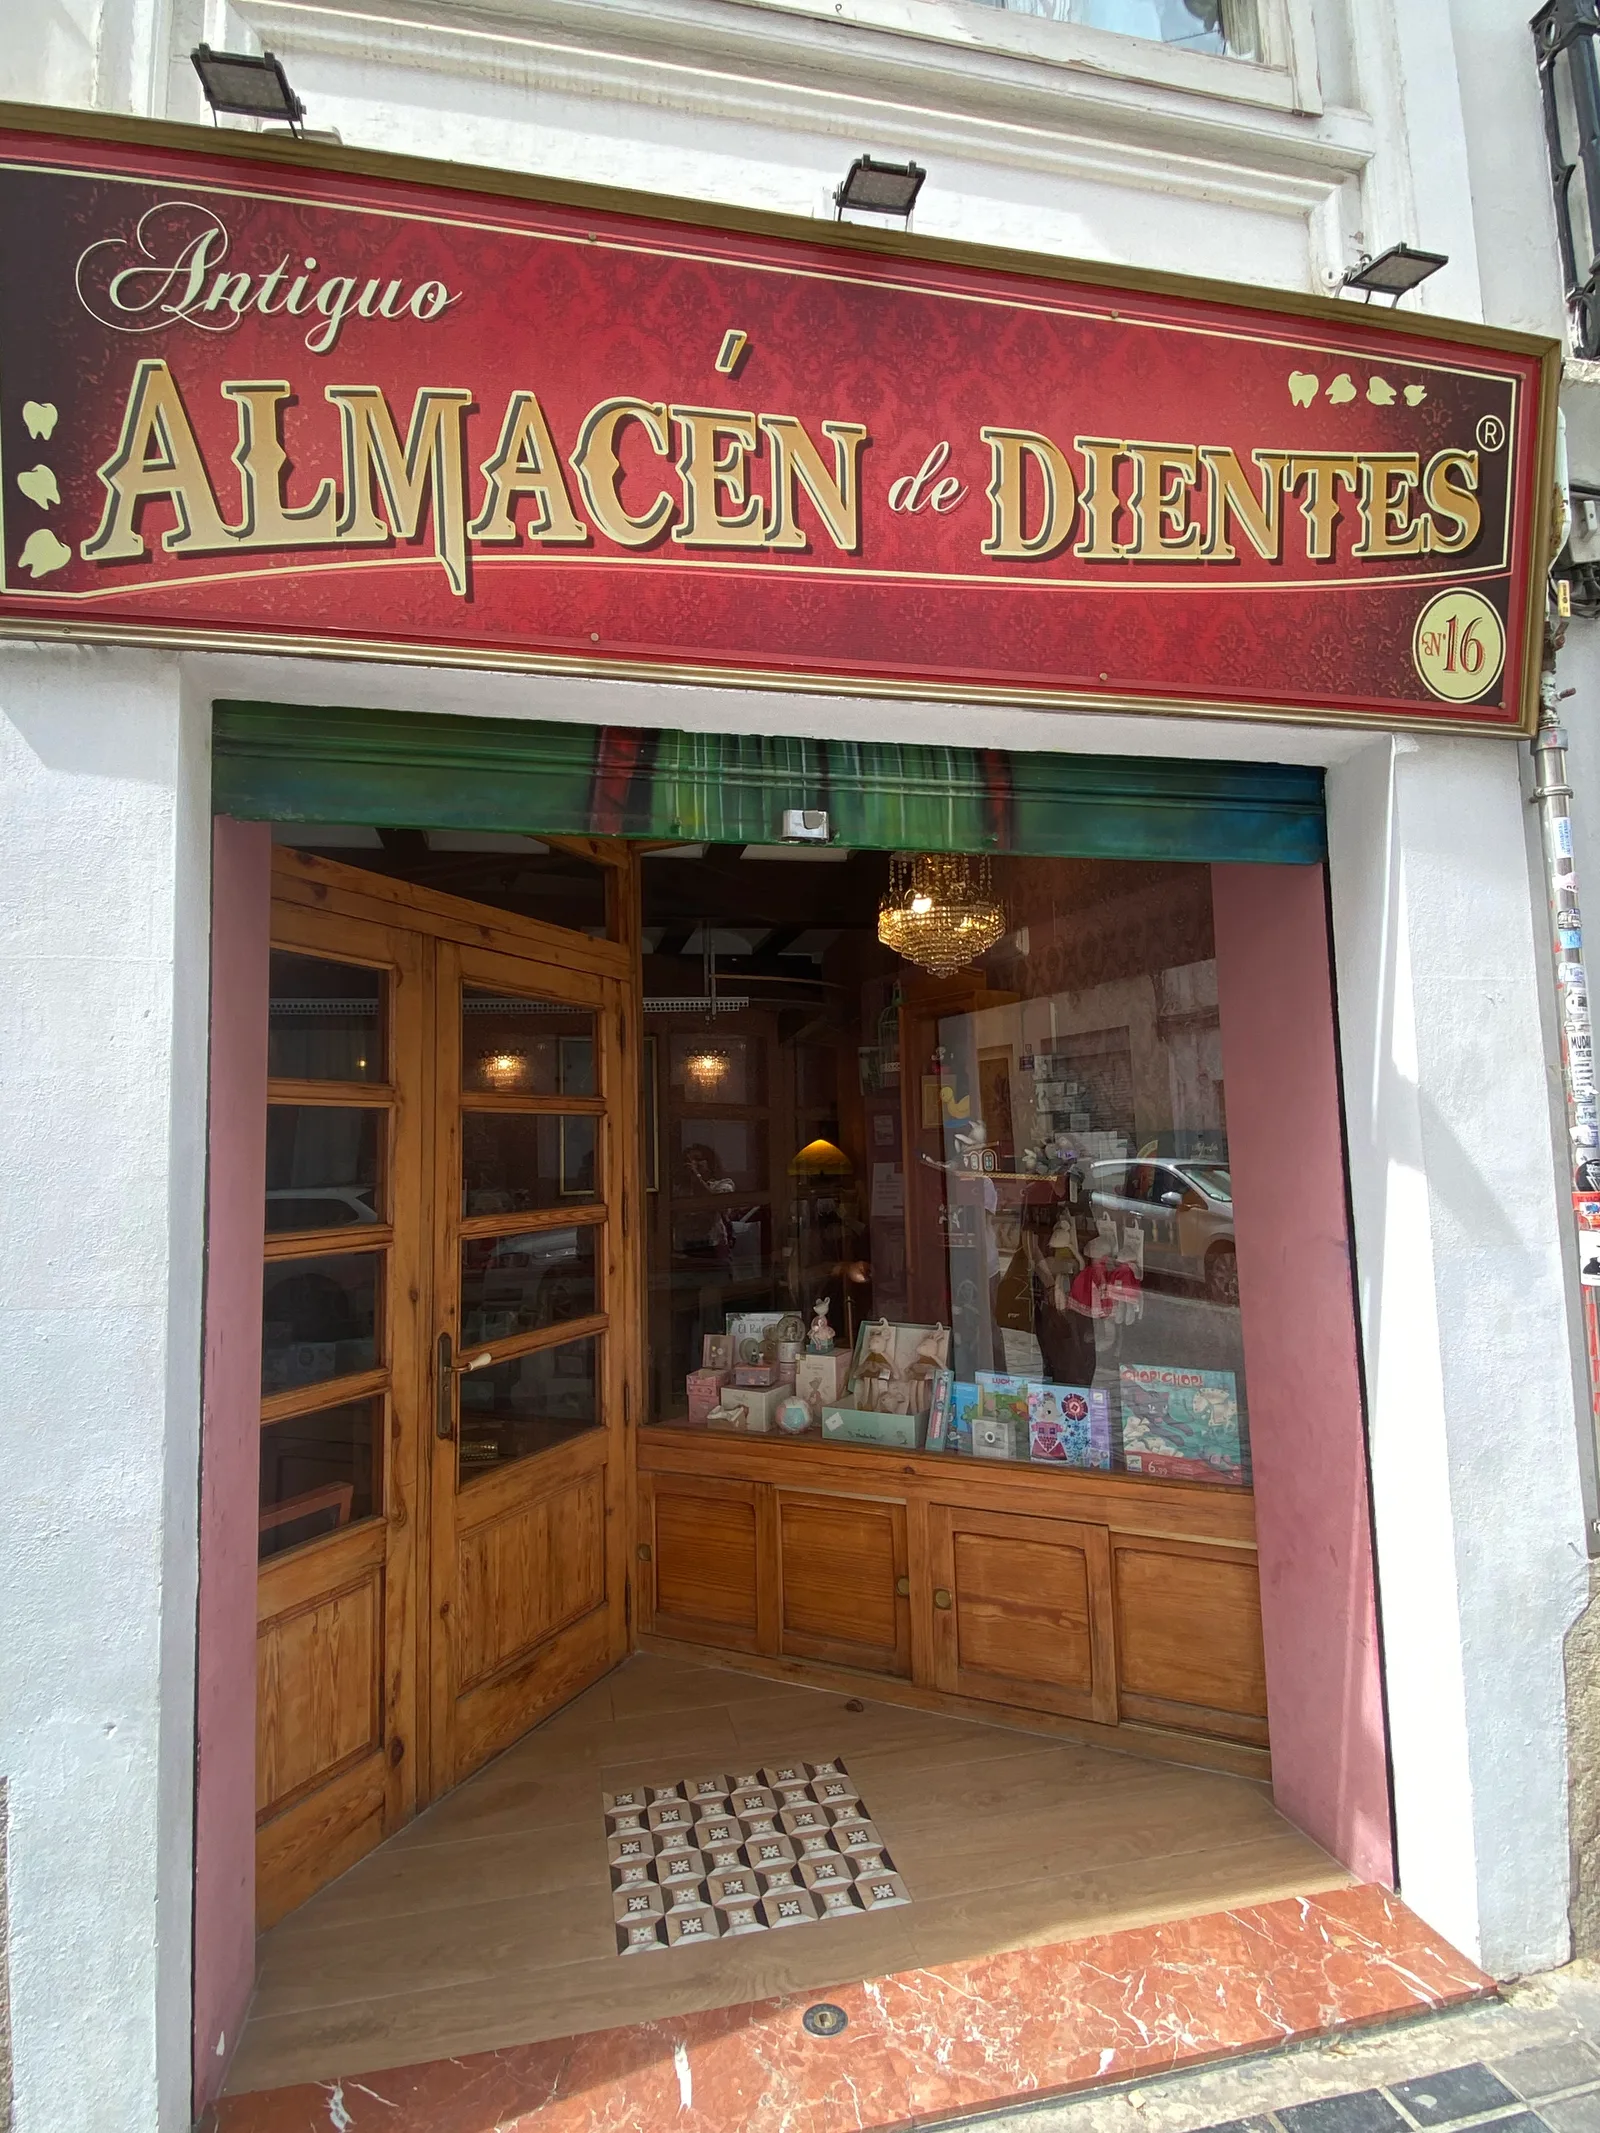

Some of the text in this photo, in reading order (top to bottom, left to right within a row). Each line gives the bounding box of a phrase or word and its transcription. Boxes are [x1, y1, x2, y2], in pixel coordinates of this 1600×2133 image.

[75, 201, 463, 354] Antiguo
[80, 329, 867, 596] ALMACÉN
[887, 440, 970, 514] de
[980, 426, 1481, 562] DIENTES
